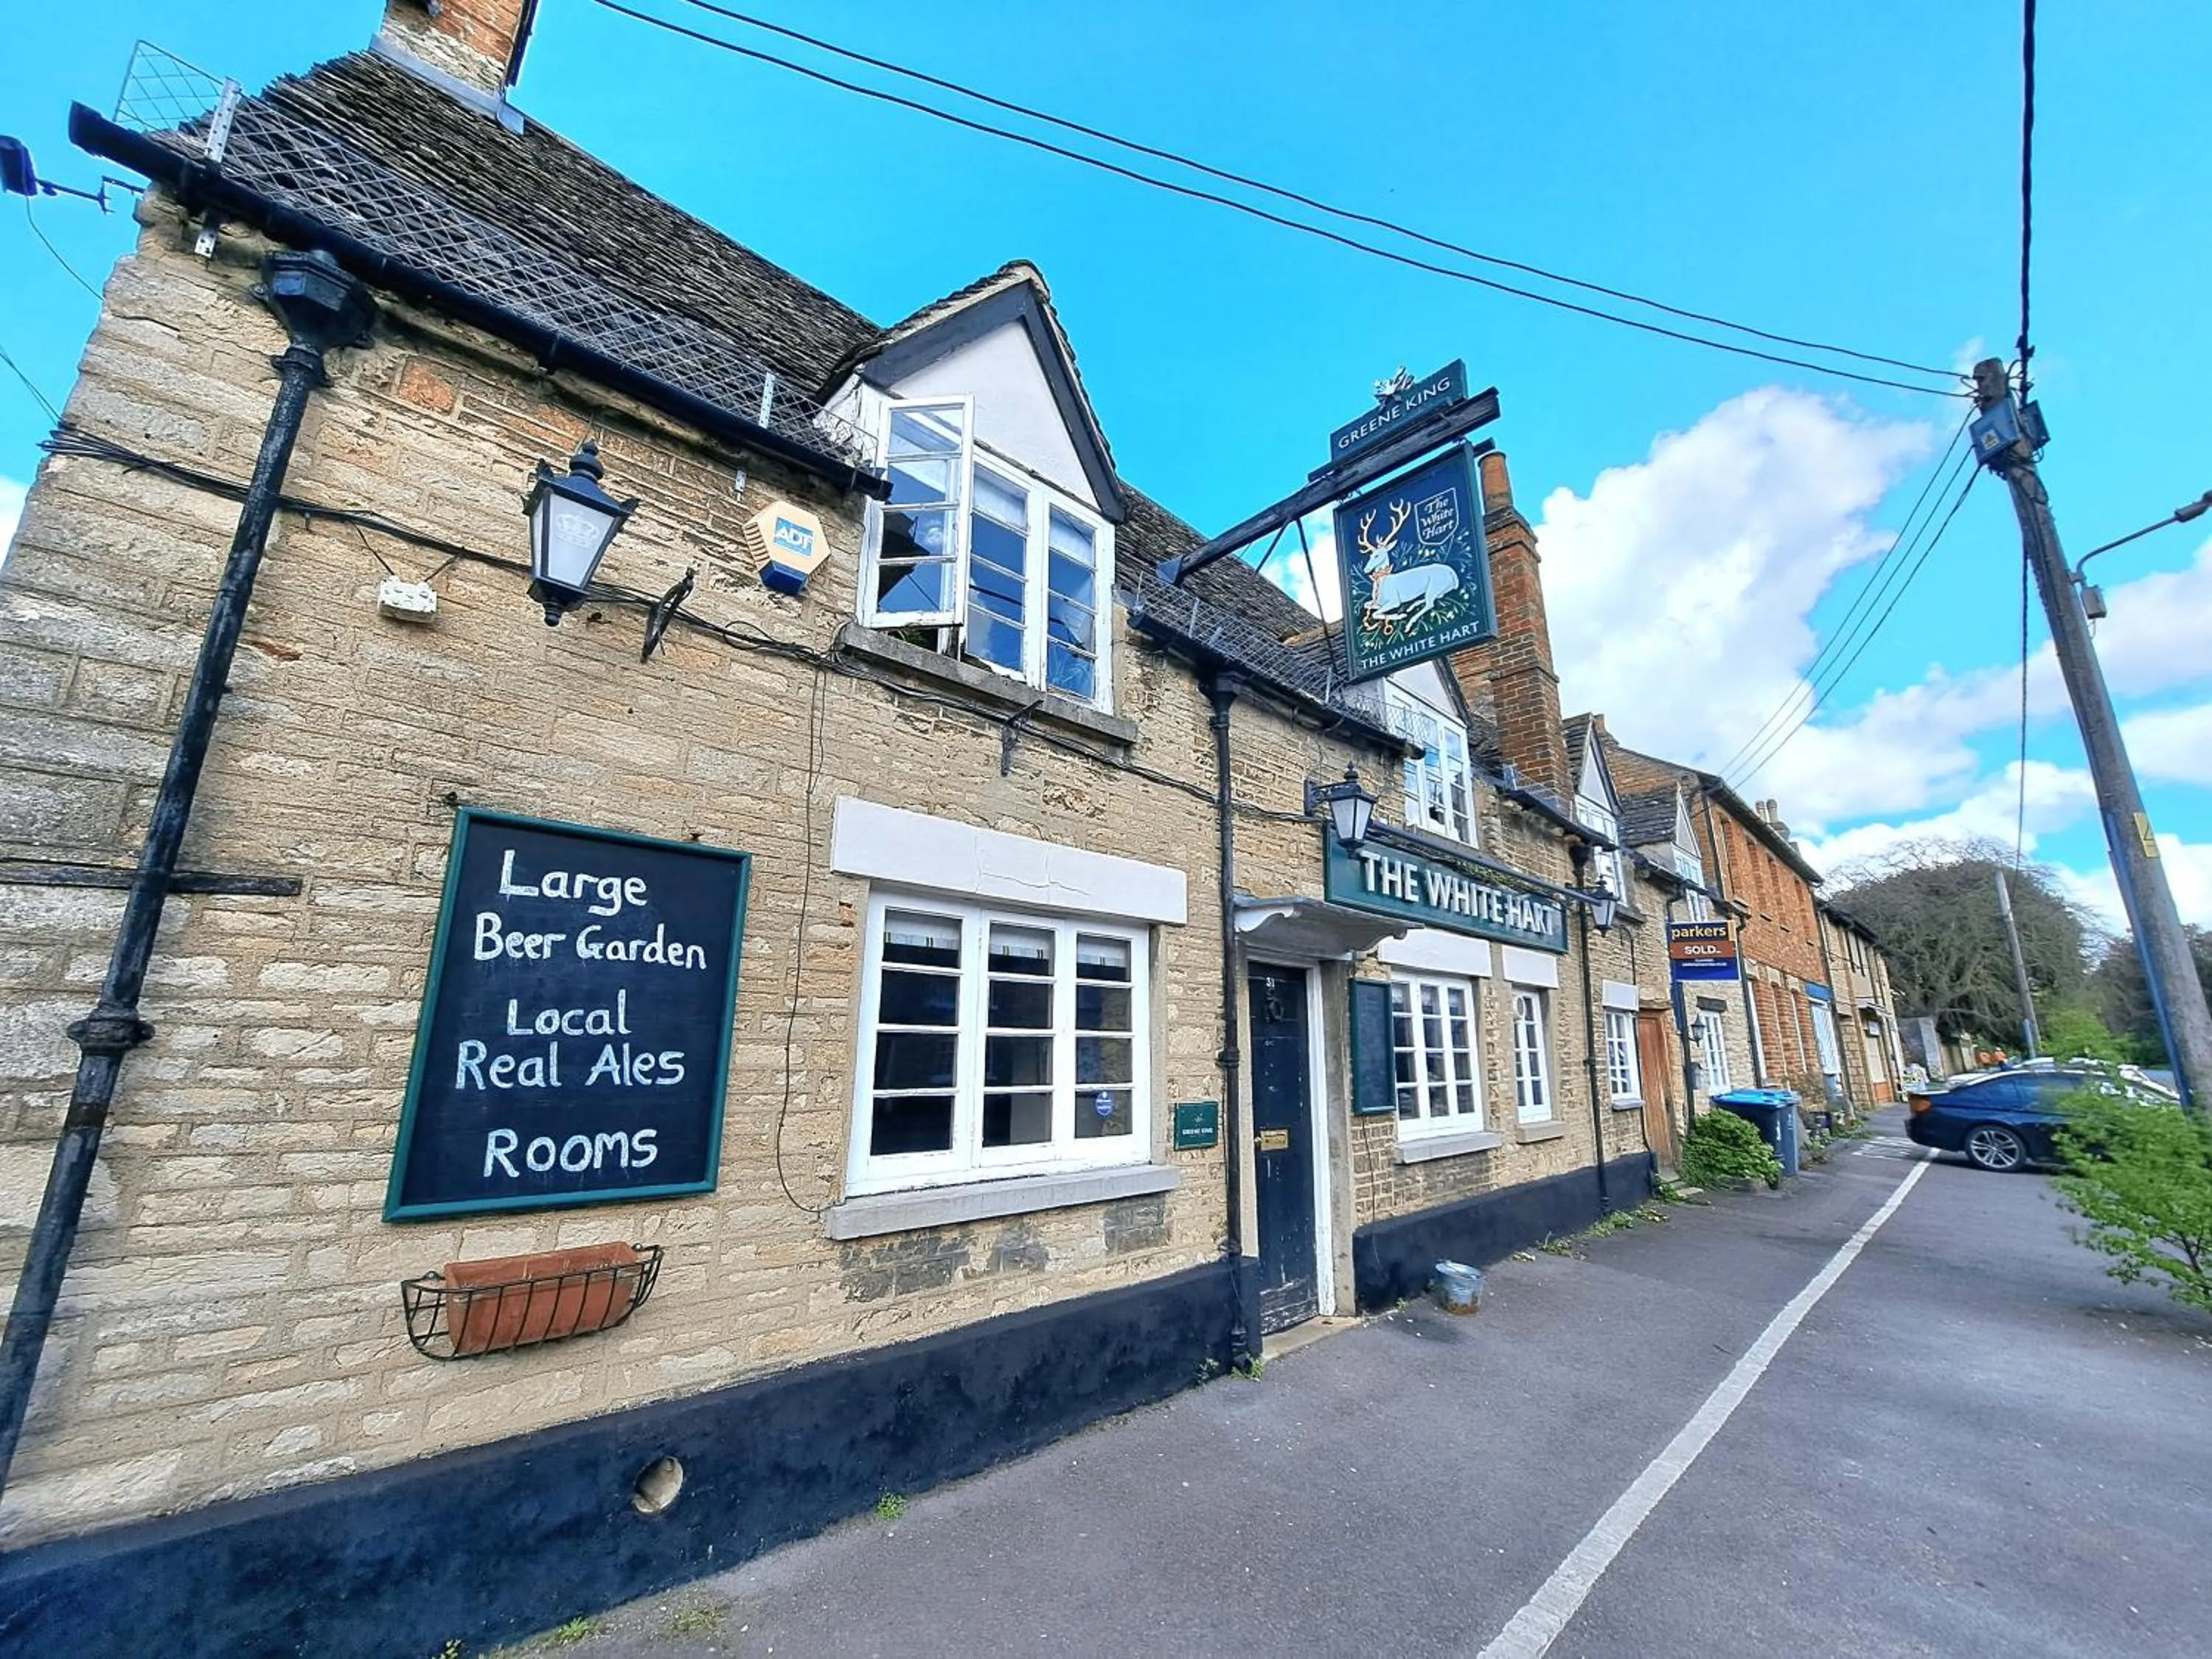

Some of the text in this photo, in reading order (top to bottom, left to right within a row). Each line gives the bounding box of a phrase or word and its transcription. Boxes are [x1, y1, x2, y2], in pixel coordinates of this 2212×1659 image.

[1338, 377, 1451, 448] GREENE KING
[775, 525, 813, 549] ADT
[1360, 620, 1480, 669] THE WHITE HART
[498, 849, 648, 917] Large
[1360, 850, 1557, 936] THE WHITE HART
[473, 912, 707, 970] Beer Garden
[1672, 925, 1726, 940] parkers
[1685, 945, 1716, 955] SOLD
[507, 989, 632, 1036] Local
[454, 1040, 686, 1091] Real Ales
